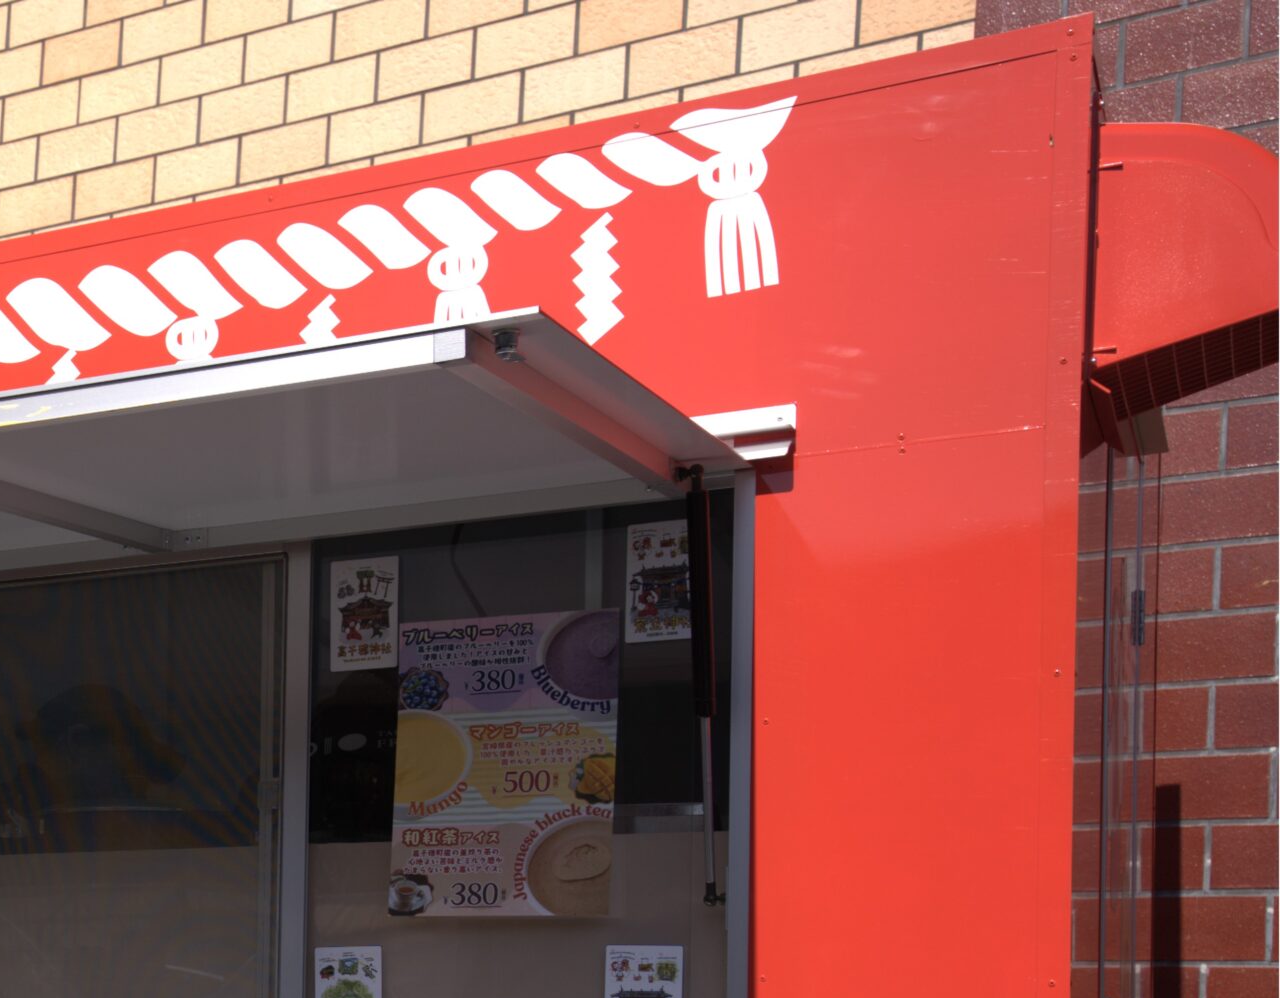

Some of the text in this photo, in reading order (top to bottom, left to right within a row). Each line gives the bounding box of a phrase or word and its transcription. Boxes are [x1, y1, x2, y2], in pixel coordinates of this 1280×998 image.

[402, 622, 534, 646] ブルーベリーアイス
[531, 665, 611, 714] Blueberry
[469, 722, 580, 740] マンゴーアイス
[408, 780, 468, 817] Mango
[402, 828, 500, 847] 和紅茶アイス
[513, 830, 538, 901] Japanese
[536, 804, 582, 831] black
[586, 804, 613, 819] tea
